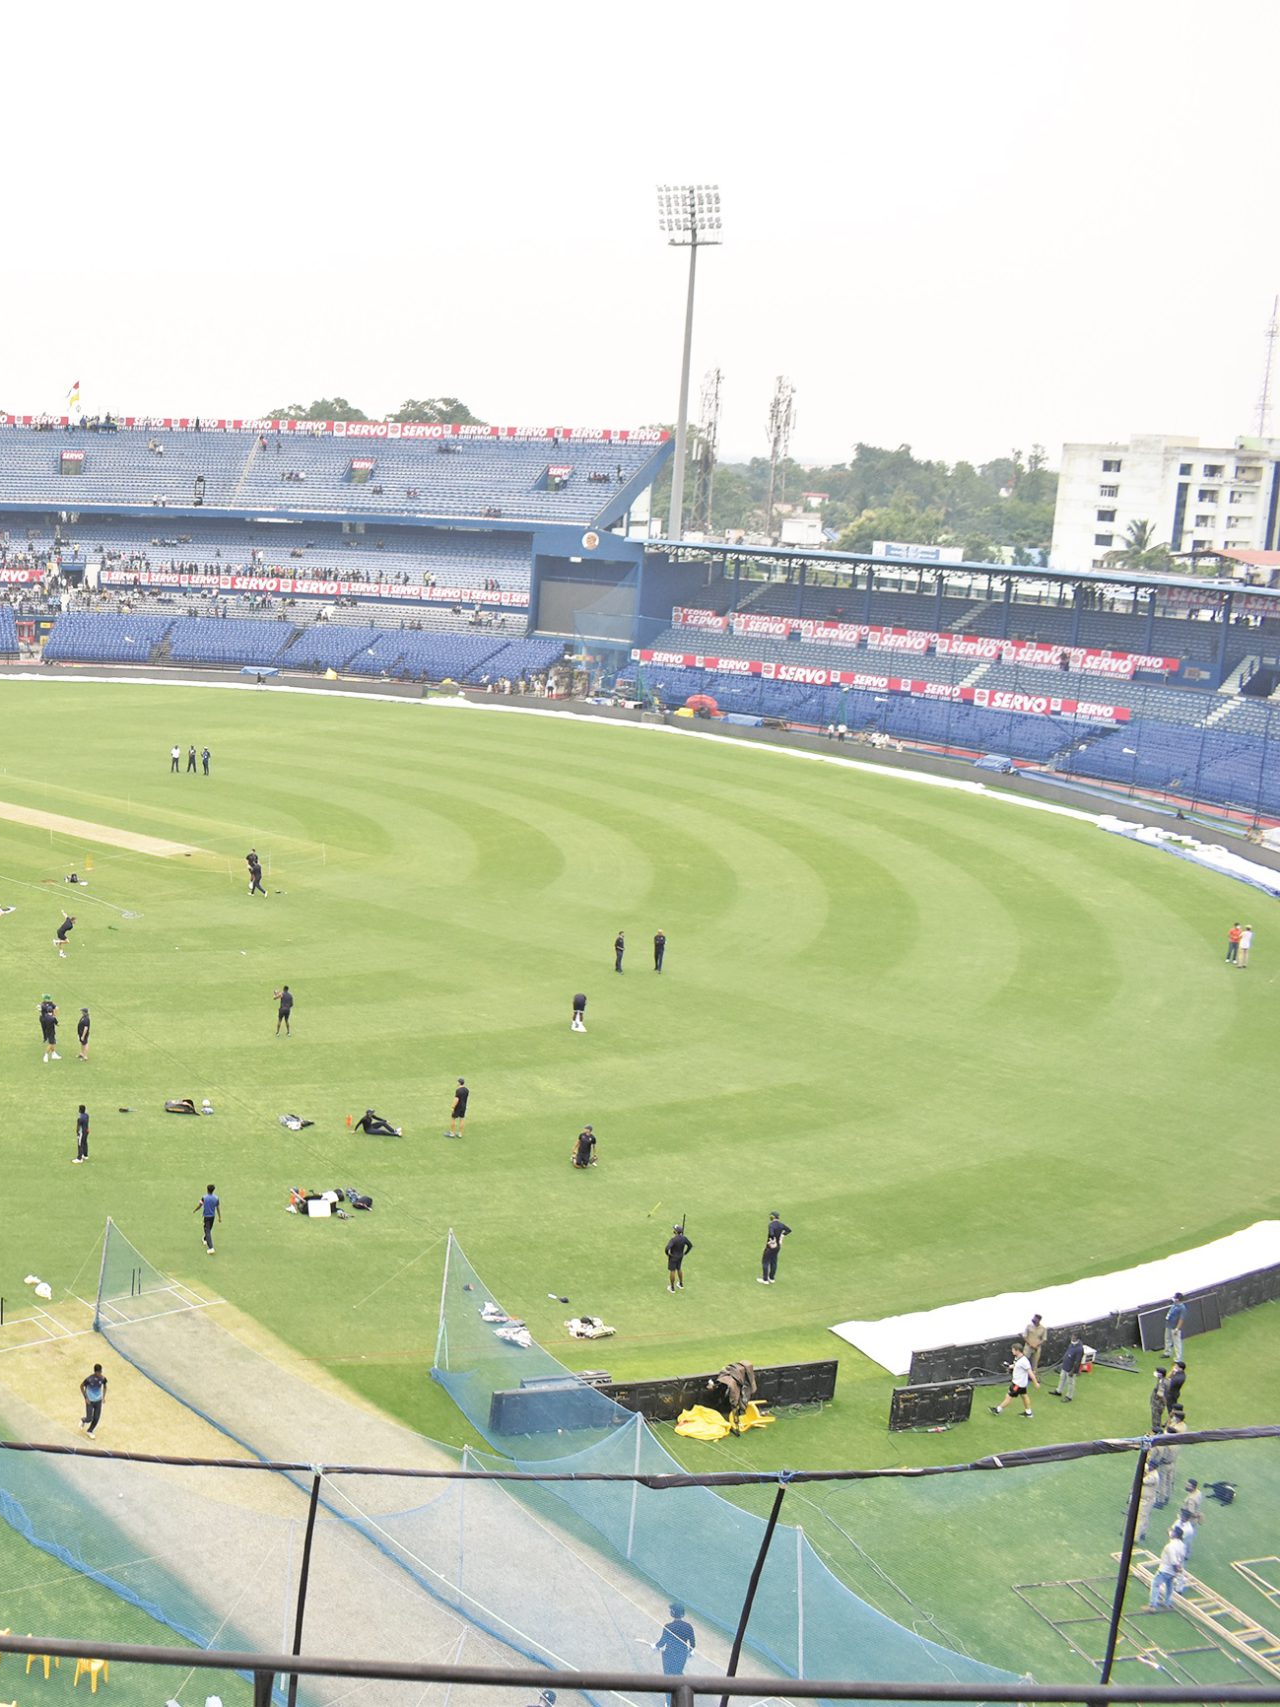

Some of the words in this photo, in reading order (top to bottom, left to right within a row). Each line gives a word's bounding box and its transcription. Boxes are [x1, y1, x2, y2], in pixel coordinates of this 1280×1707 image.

[31, 416, 61, 425] SERVO
[241, 419, 272, 430] SERVO
[295, 421, 326, 430] SERVO
[346, 423, 387, 436] SERVO
[402, 424, 443, 438] SERVO
[459, 425, 491, 435] SERVO
[514, 427, 548, 438] SERVO
[570, 428, 604, 438] SERVO
[627, 430, 661, 441] SERVO
[62, 452, 84, 460] SERVO
[150, 574, 179, 583] SERVO
[189, 575, 219, 585] SERVO
[234, 577, 277, 590] SERVO
[295, 580, 338, 593] SERVO
[349, 583, 379, 593] SERVO
[391, 585, 420, 595] SERVO
[431, 587, 461, 598] SERVO
[470, 590, 500, 602] SERVO
[686, 614, 723, 628] SERVO
[748, 620, 785, 634] SERVO
[783, 617, 814, 628] SERVO
[814, 626, 857, 642] SERVO
[838, 623, 869, 634] SERVO
[880, 633, 926, 650] SERVO
[907, 630, 939, 642] SERVO
[949, 640, 997, 657] SERVO
[651, 651, 684, 664] SERVO
[1083, 655, 1132, 673] SERVO
[1127, 654, 1163, 668] SERVO
[717, 658, 750, 671] SERVO
[778, 665, 827, 684] SERVO
[853, 674, 888, 688] SERVO
[924, 683, 961, 697] SERVO
[991, 692, 1047, 713] SERVO
[1076, 702, 1114, 717] SERVO
